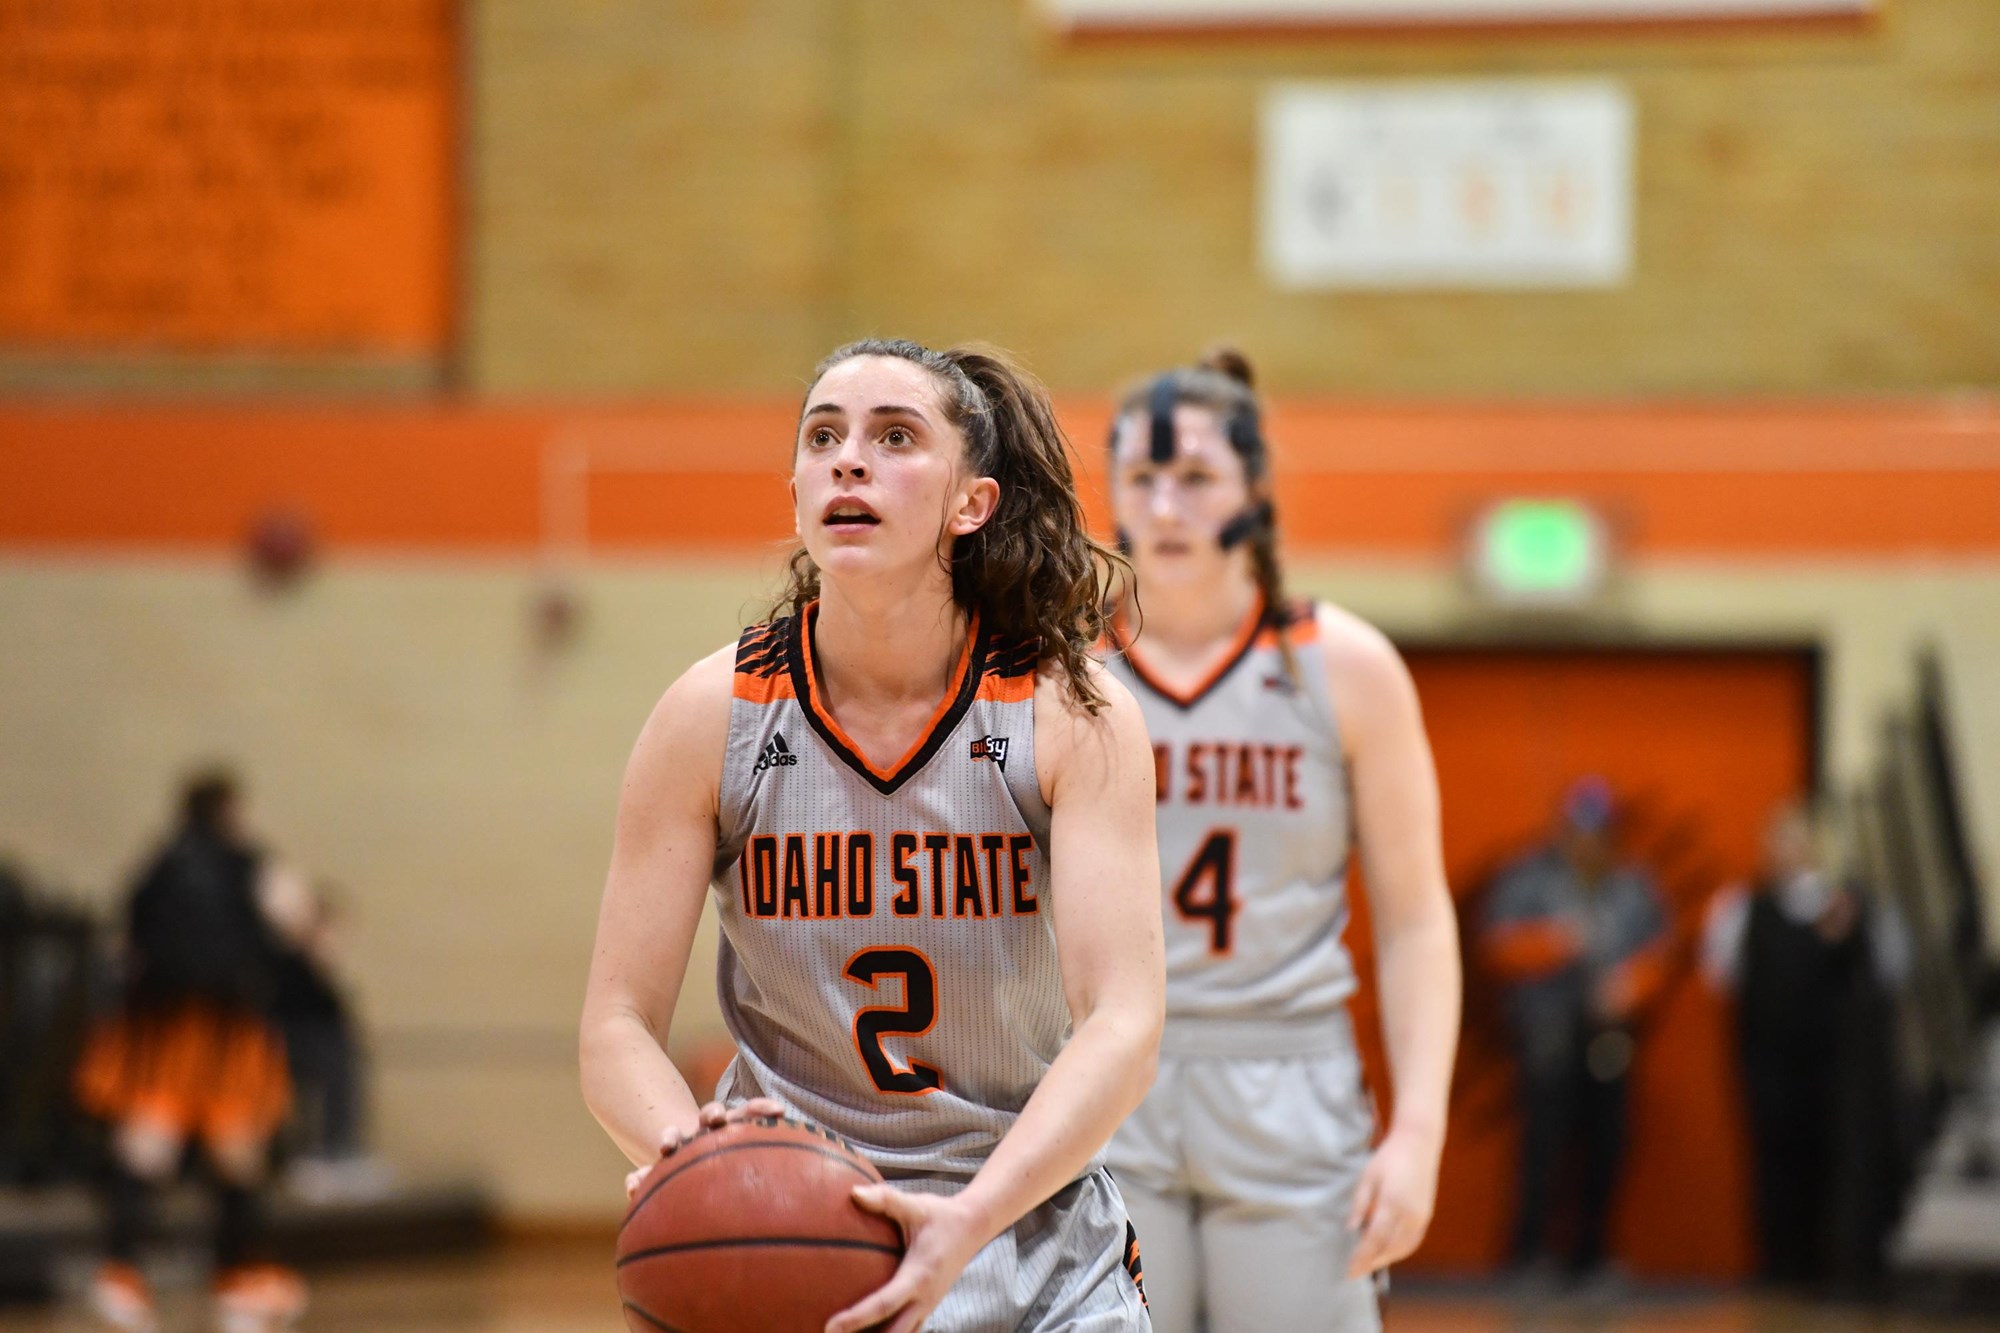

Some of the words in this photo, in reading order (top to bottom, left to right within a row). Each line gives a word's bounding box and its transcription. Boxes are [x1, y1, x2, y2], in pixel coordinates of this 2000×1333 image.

[1186, 741, 1304, 810] STATE
[738, 831, 875, 919] IDAHO
[890, 831, 1039, 919] STATE
[1171, 826, 1243, 959] 4
[842, 945, 944, 1096] 2
